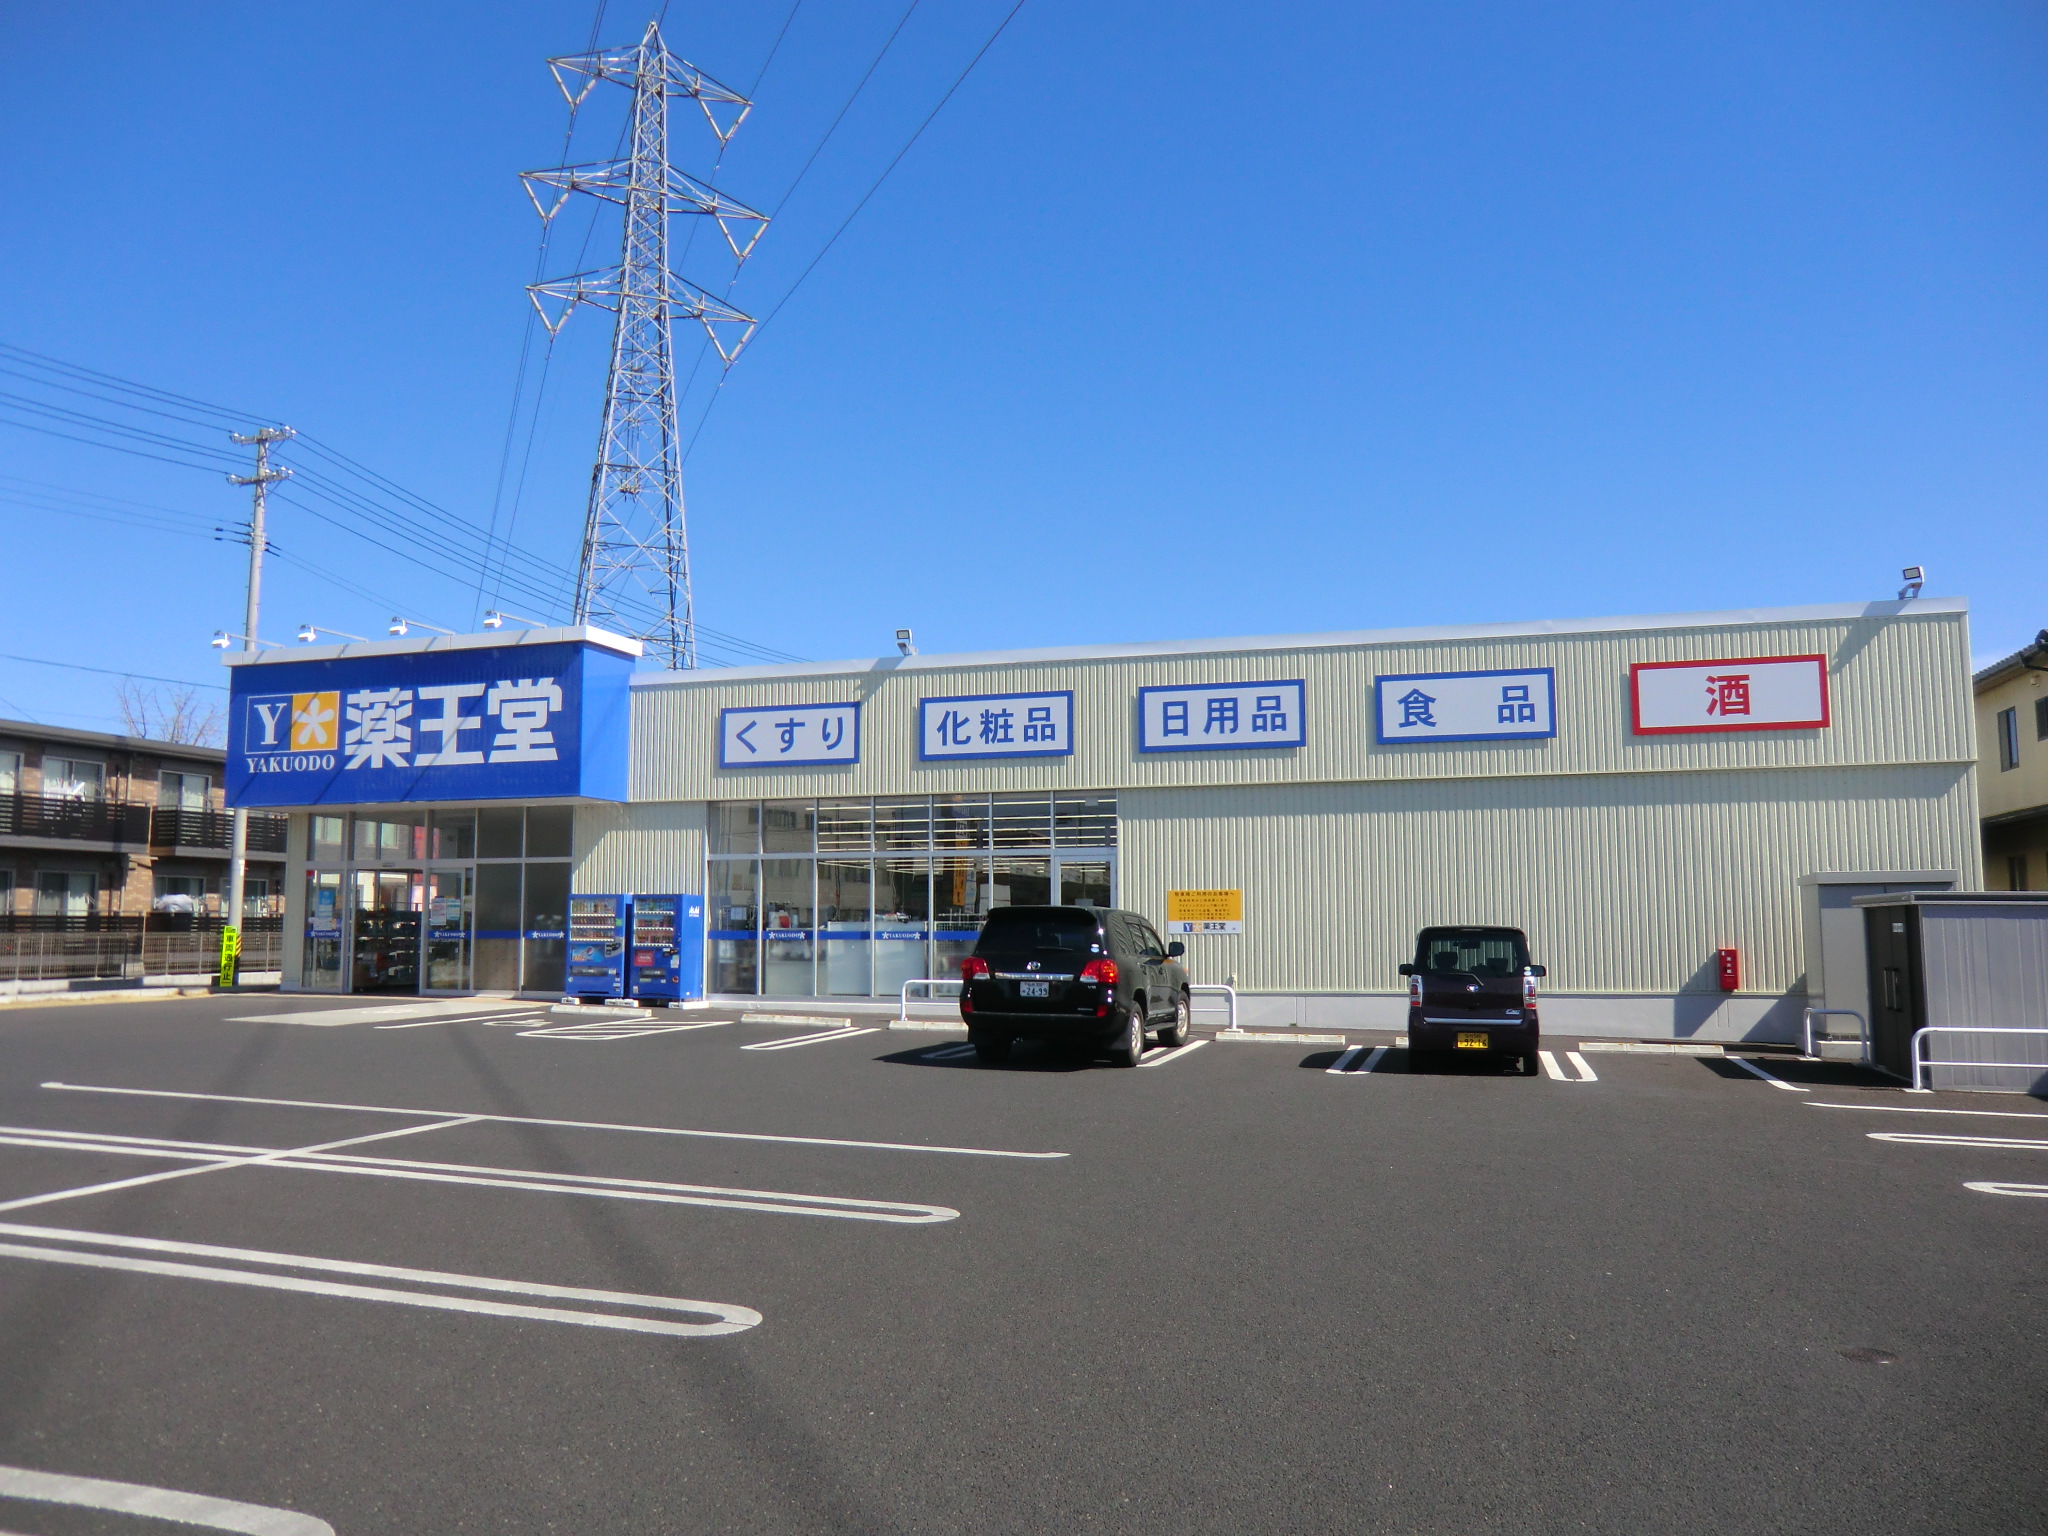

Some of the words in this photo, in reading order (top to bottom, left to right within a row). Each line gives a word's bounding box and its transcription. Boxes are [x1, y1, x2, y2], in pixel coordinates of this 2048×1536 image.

[1704, 674, 1751, 716] 酒
[344, 677, 563, 770] 薬王堂
[735, 716, 844, 754] くすり
[936, 706, 1056, 746] 化粧品
[1162, 695, 1288, 737] 日用品
[246, 754, 335, 773] YAKUODO
